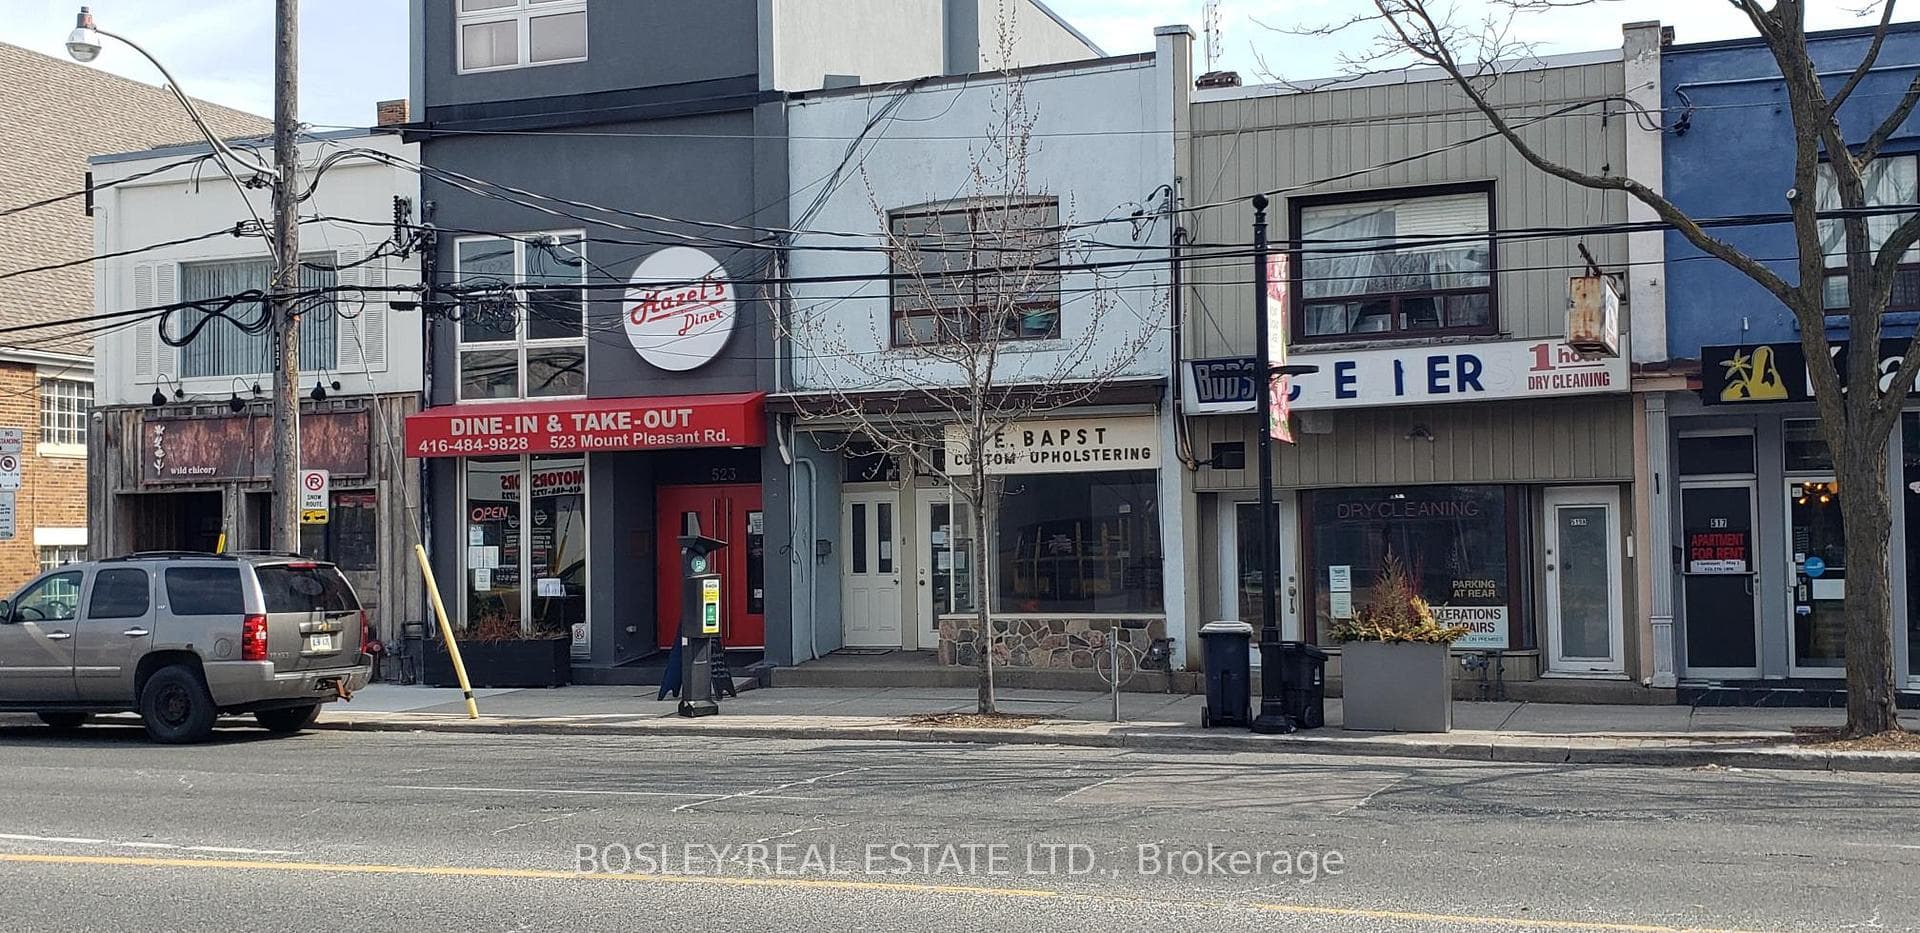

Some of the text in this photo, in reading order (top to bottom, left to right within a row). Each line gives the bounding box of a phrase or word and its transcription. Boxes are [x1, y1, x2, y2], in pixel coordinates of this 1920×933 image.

[630, 276, 725, 325] Hazel's
[678, 310, 723, 336] Diner
[1529, 343, 1556, 372] 1
[1528, 371, 1610, 390] DRY CLEANING
[451, 408, 693, 436] DINE-IN & TAKE-OUT
[418, 428, 731, 453] 416-484-9828 523 Mount Pleasant Rd.
[994, 427, 1107, 449] E. BAPST
[954, 446, 1152, 466] CUTOM UPHOLSTERING
[170, 465, 217, 476] wild chicory
[711, 466, 736, 481] 523
[471, 506, 509, 521] OPEN
[1710, 518, 1728, 528] 517
[1691, 532, 1745, 547] APARTMENT
[1691, 546, 1745, 560] FOR RENT
[1452, 579, 1496, 589] PARKING
[1453, 589, 1496, 598] AT REAR
